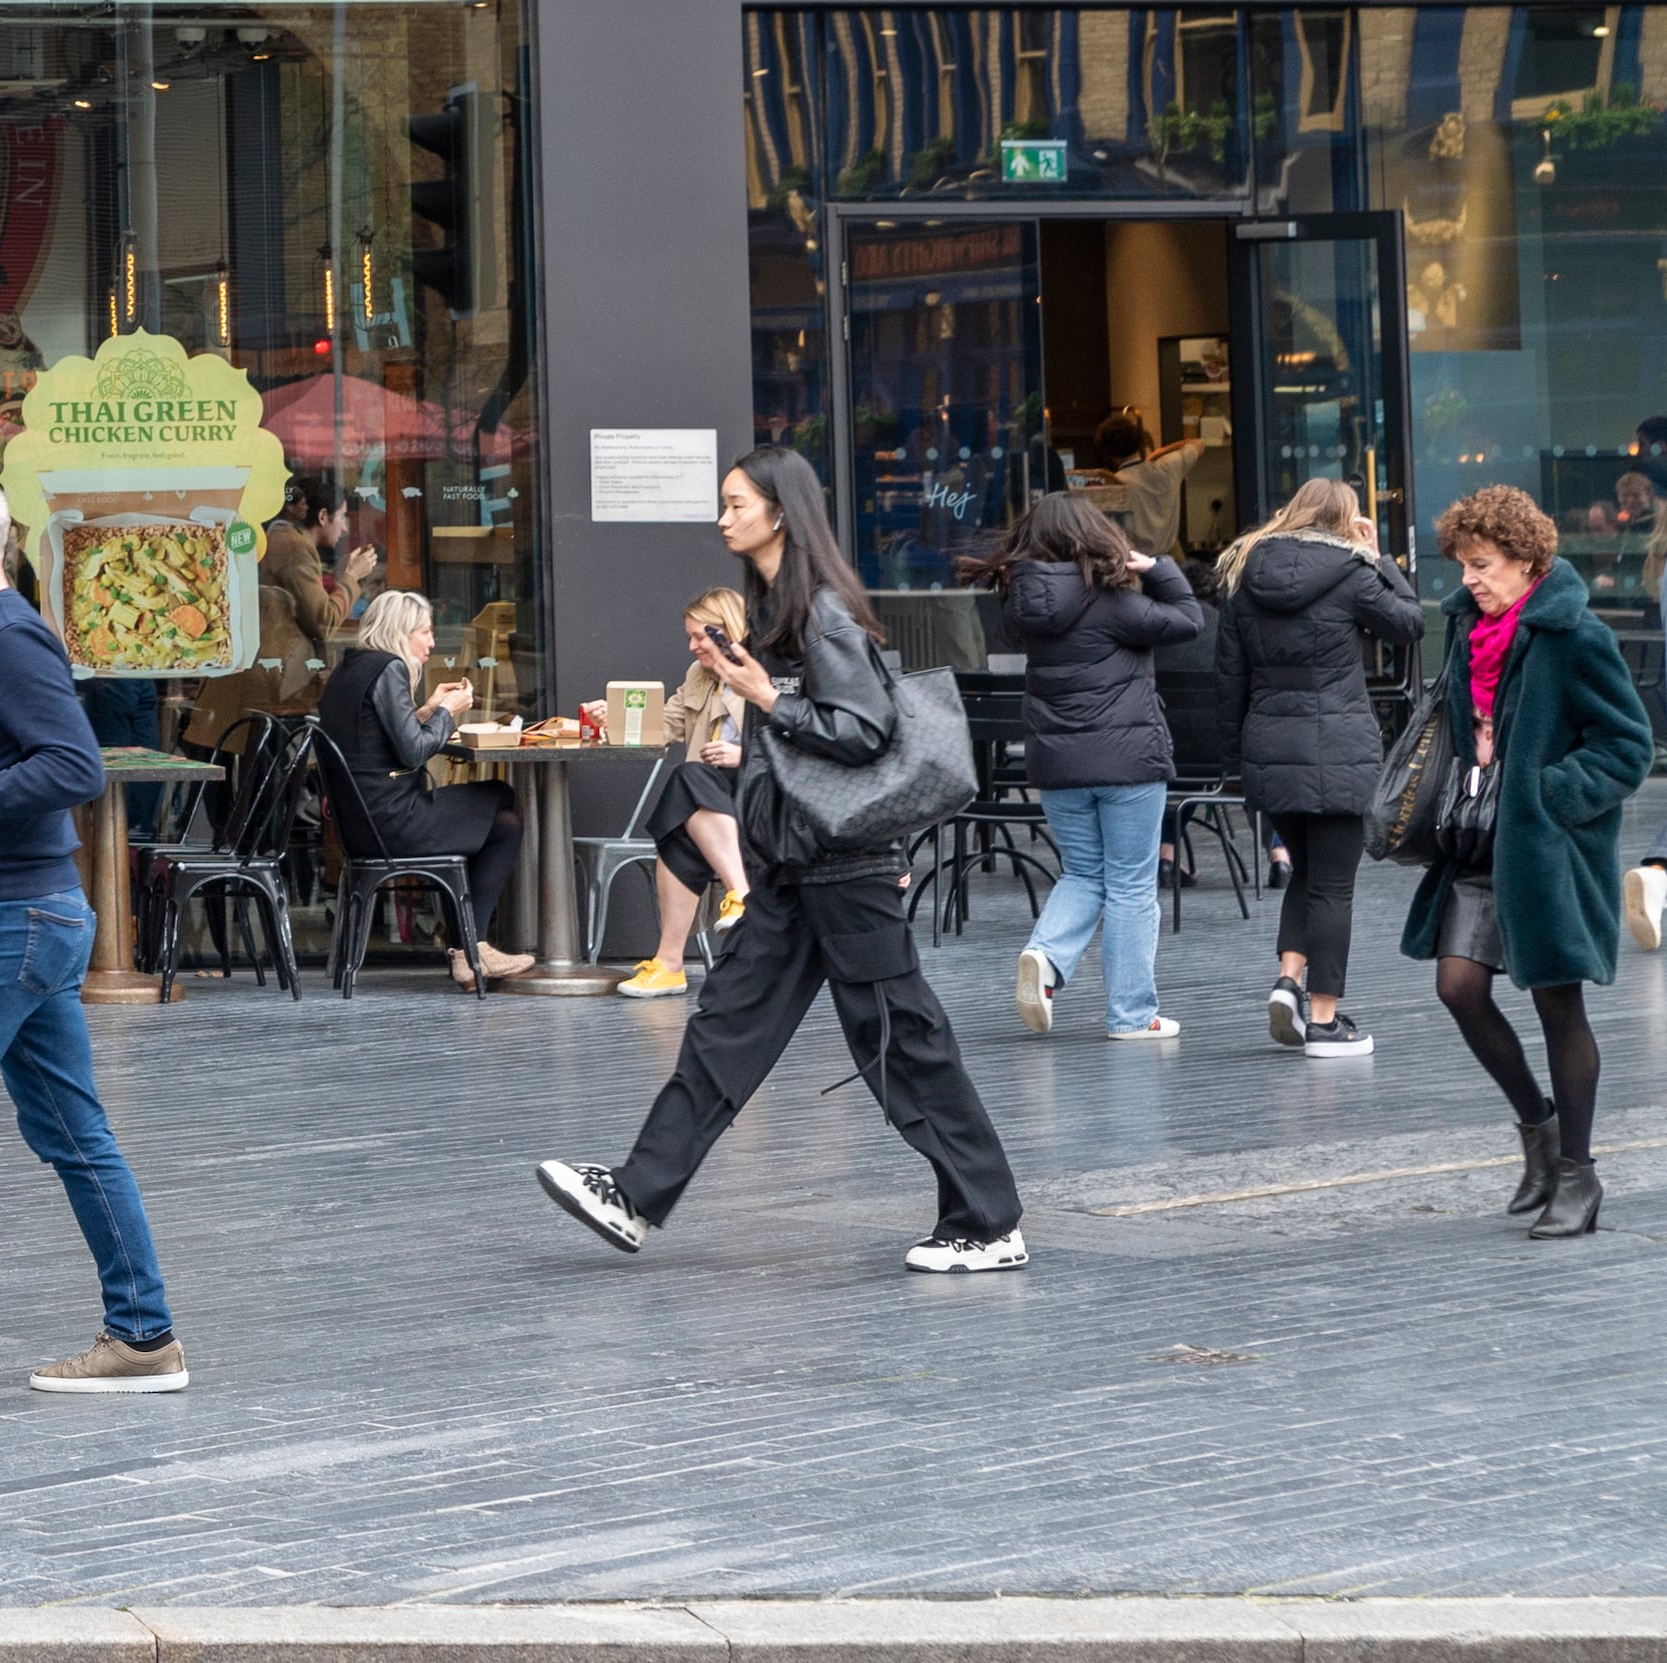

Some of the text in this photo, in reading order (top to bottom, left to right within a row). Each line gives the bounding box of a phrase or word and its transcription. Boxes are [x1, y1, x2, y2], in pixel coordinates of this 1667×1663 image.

[48, 400, 238, 424] THAI GREEN
[48, 424, 238, 444] CHICKEN CURRY
[442, 485, 486, 493] NATURALLY
[442, 492, 485, 500] FAST FOOD
[926, 481, 977, 520] Hej
[230, 529, 252, 547] NEW
